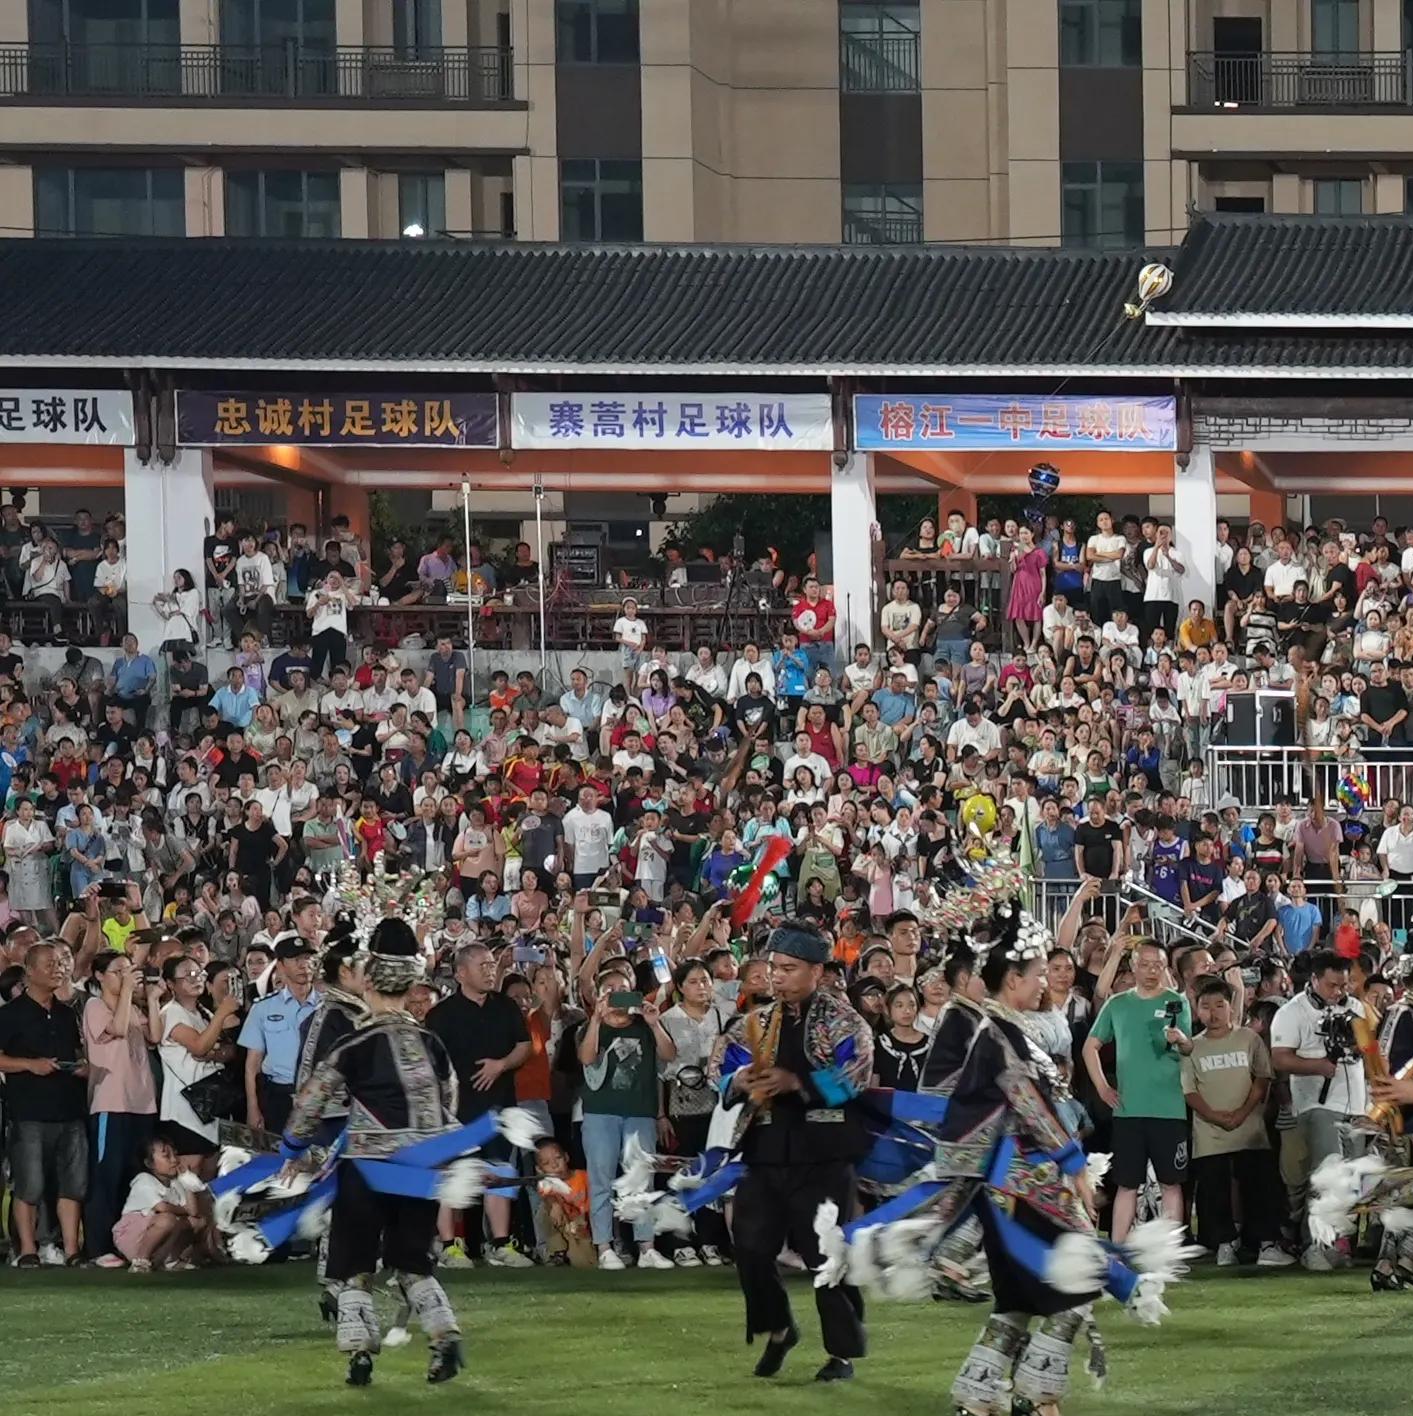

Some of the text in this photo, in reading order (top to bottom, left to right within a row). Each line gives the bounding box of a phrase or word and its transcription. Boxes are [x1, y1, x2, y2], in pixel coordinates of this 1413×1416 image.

[0, 396, 108, 433] 足球队
[213, 399, 462, 438] 忠诚村足球队
[548, 400, 795, 439] 寨蒿村足球队
[878, 401, 1154, 441] 榕江一中足球队
